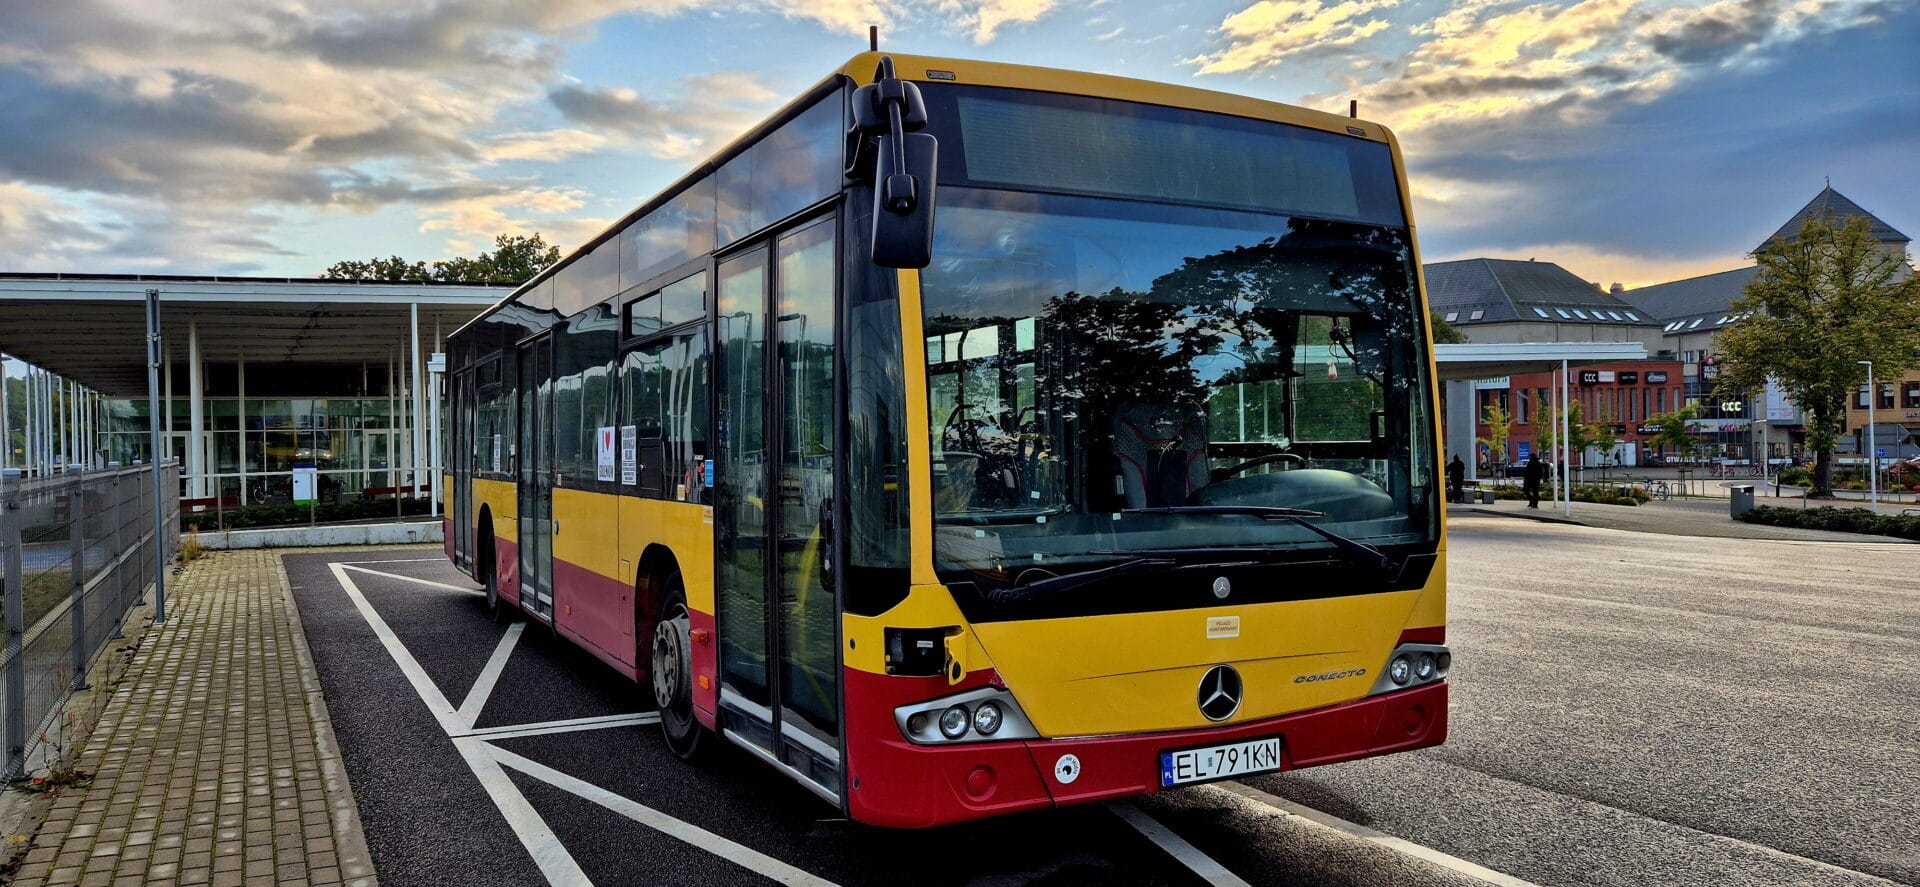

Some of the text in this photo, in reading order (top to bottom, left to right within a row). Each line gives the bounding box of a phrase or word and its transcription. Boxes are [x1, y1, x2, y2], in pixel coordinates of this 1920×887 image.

[1584, 373, 1596, 382] CCC
[1721, 402, 1742, 412] CCC
[1294, 668, 1367, 683] CONECTO
[1177, 742, 1277, 780] EL 791KN
[1165, 771, 1173, 779] PL
